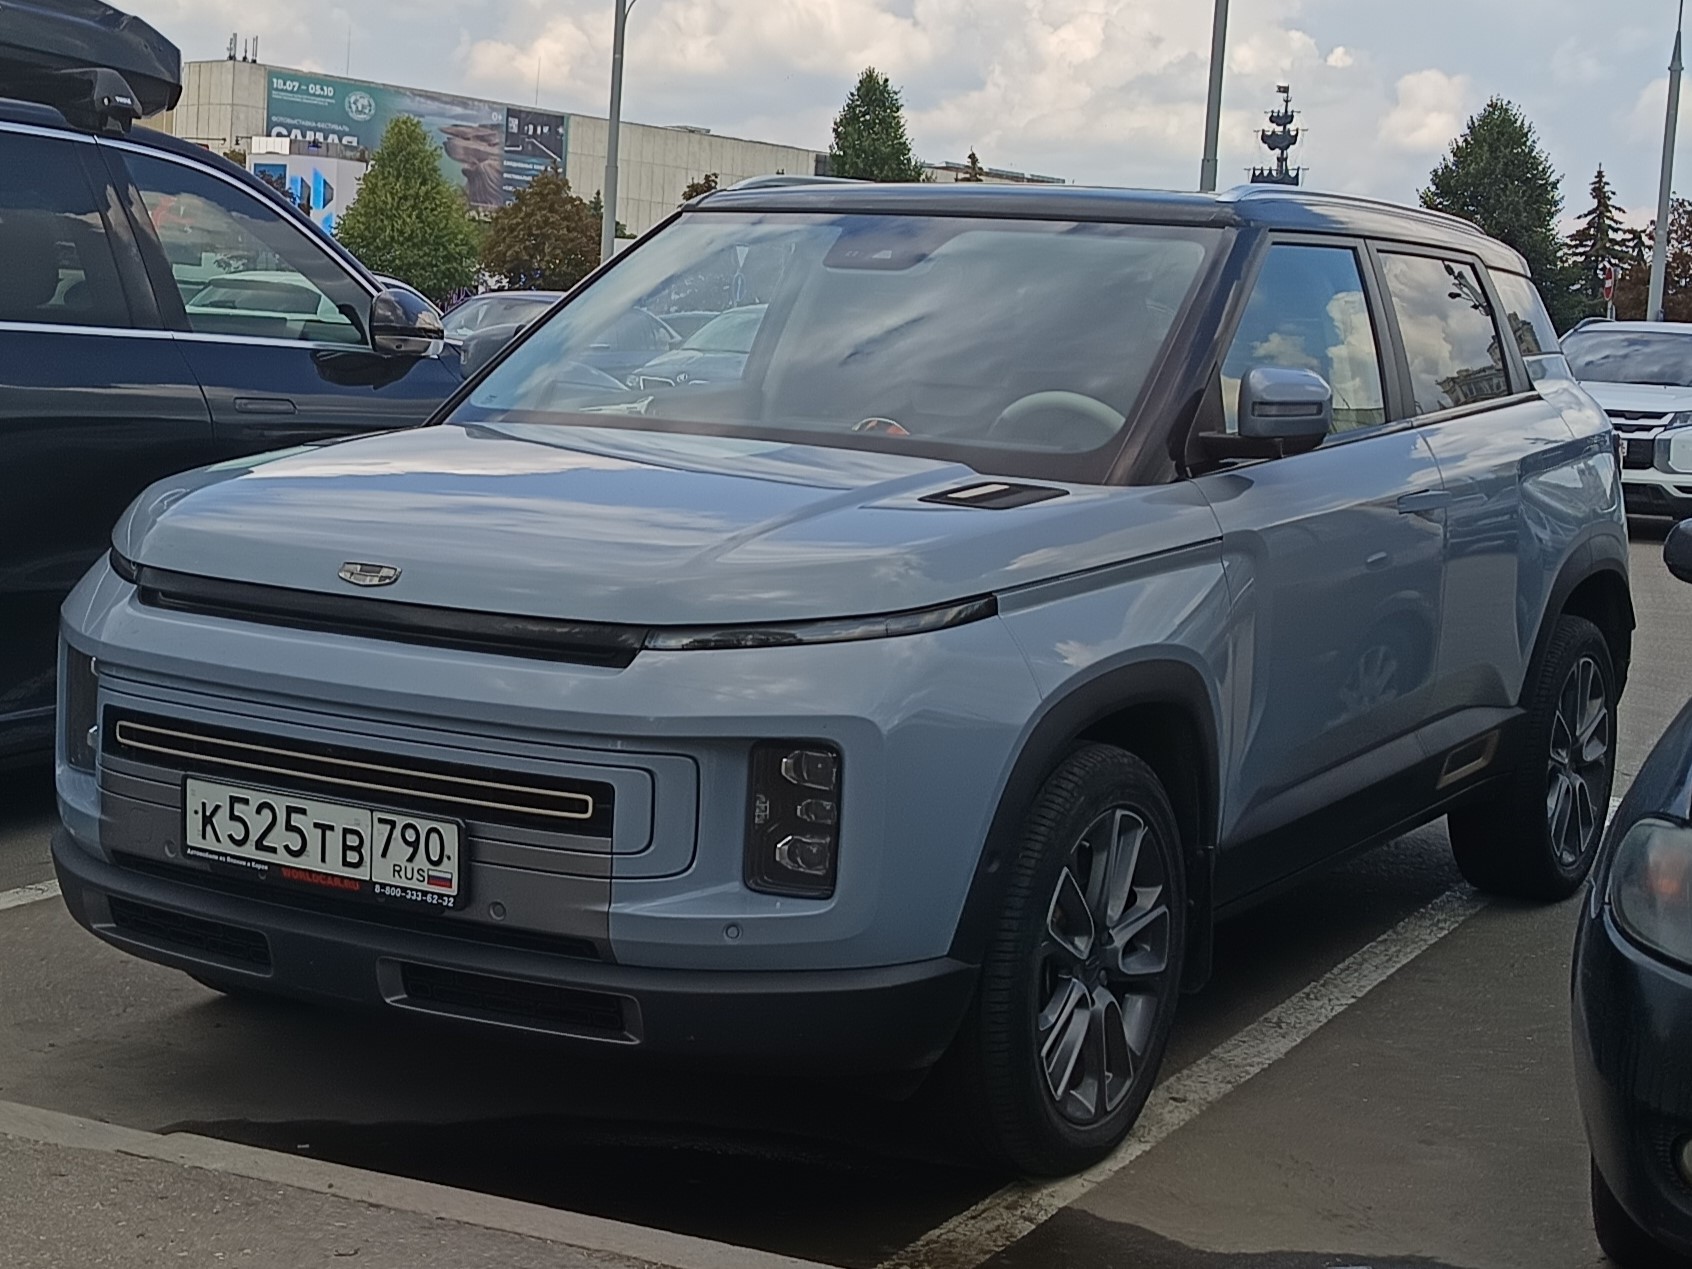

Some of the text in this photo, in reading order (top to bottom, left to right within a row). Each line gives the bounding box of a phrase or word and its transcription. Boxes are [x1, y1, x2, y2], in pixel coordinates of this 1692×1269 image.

[272, 78, 299, 92] 18.07
[308, 84, 334, 97] 05.10
[377, 817, 446, 867] 790
[392, 862, 426, 883] RUS
[374, 884, 455, 908] 8-800-333-62-32
